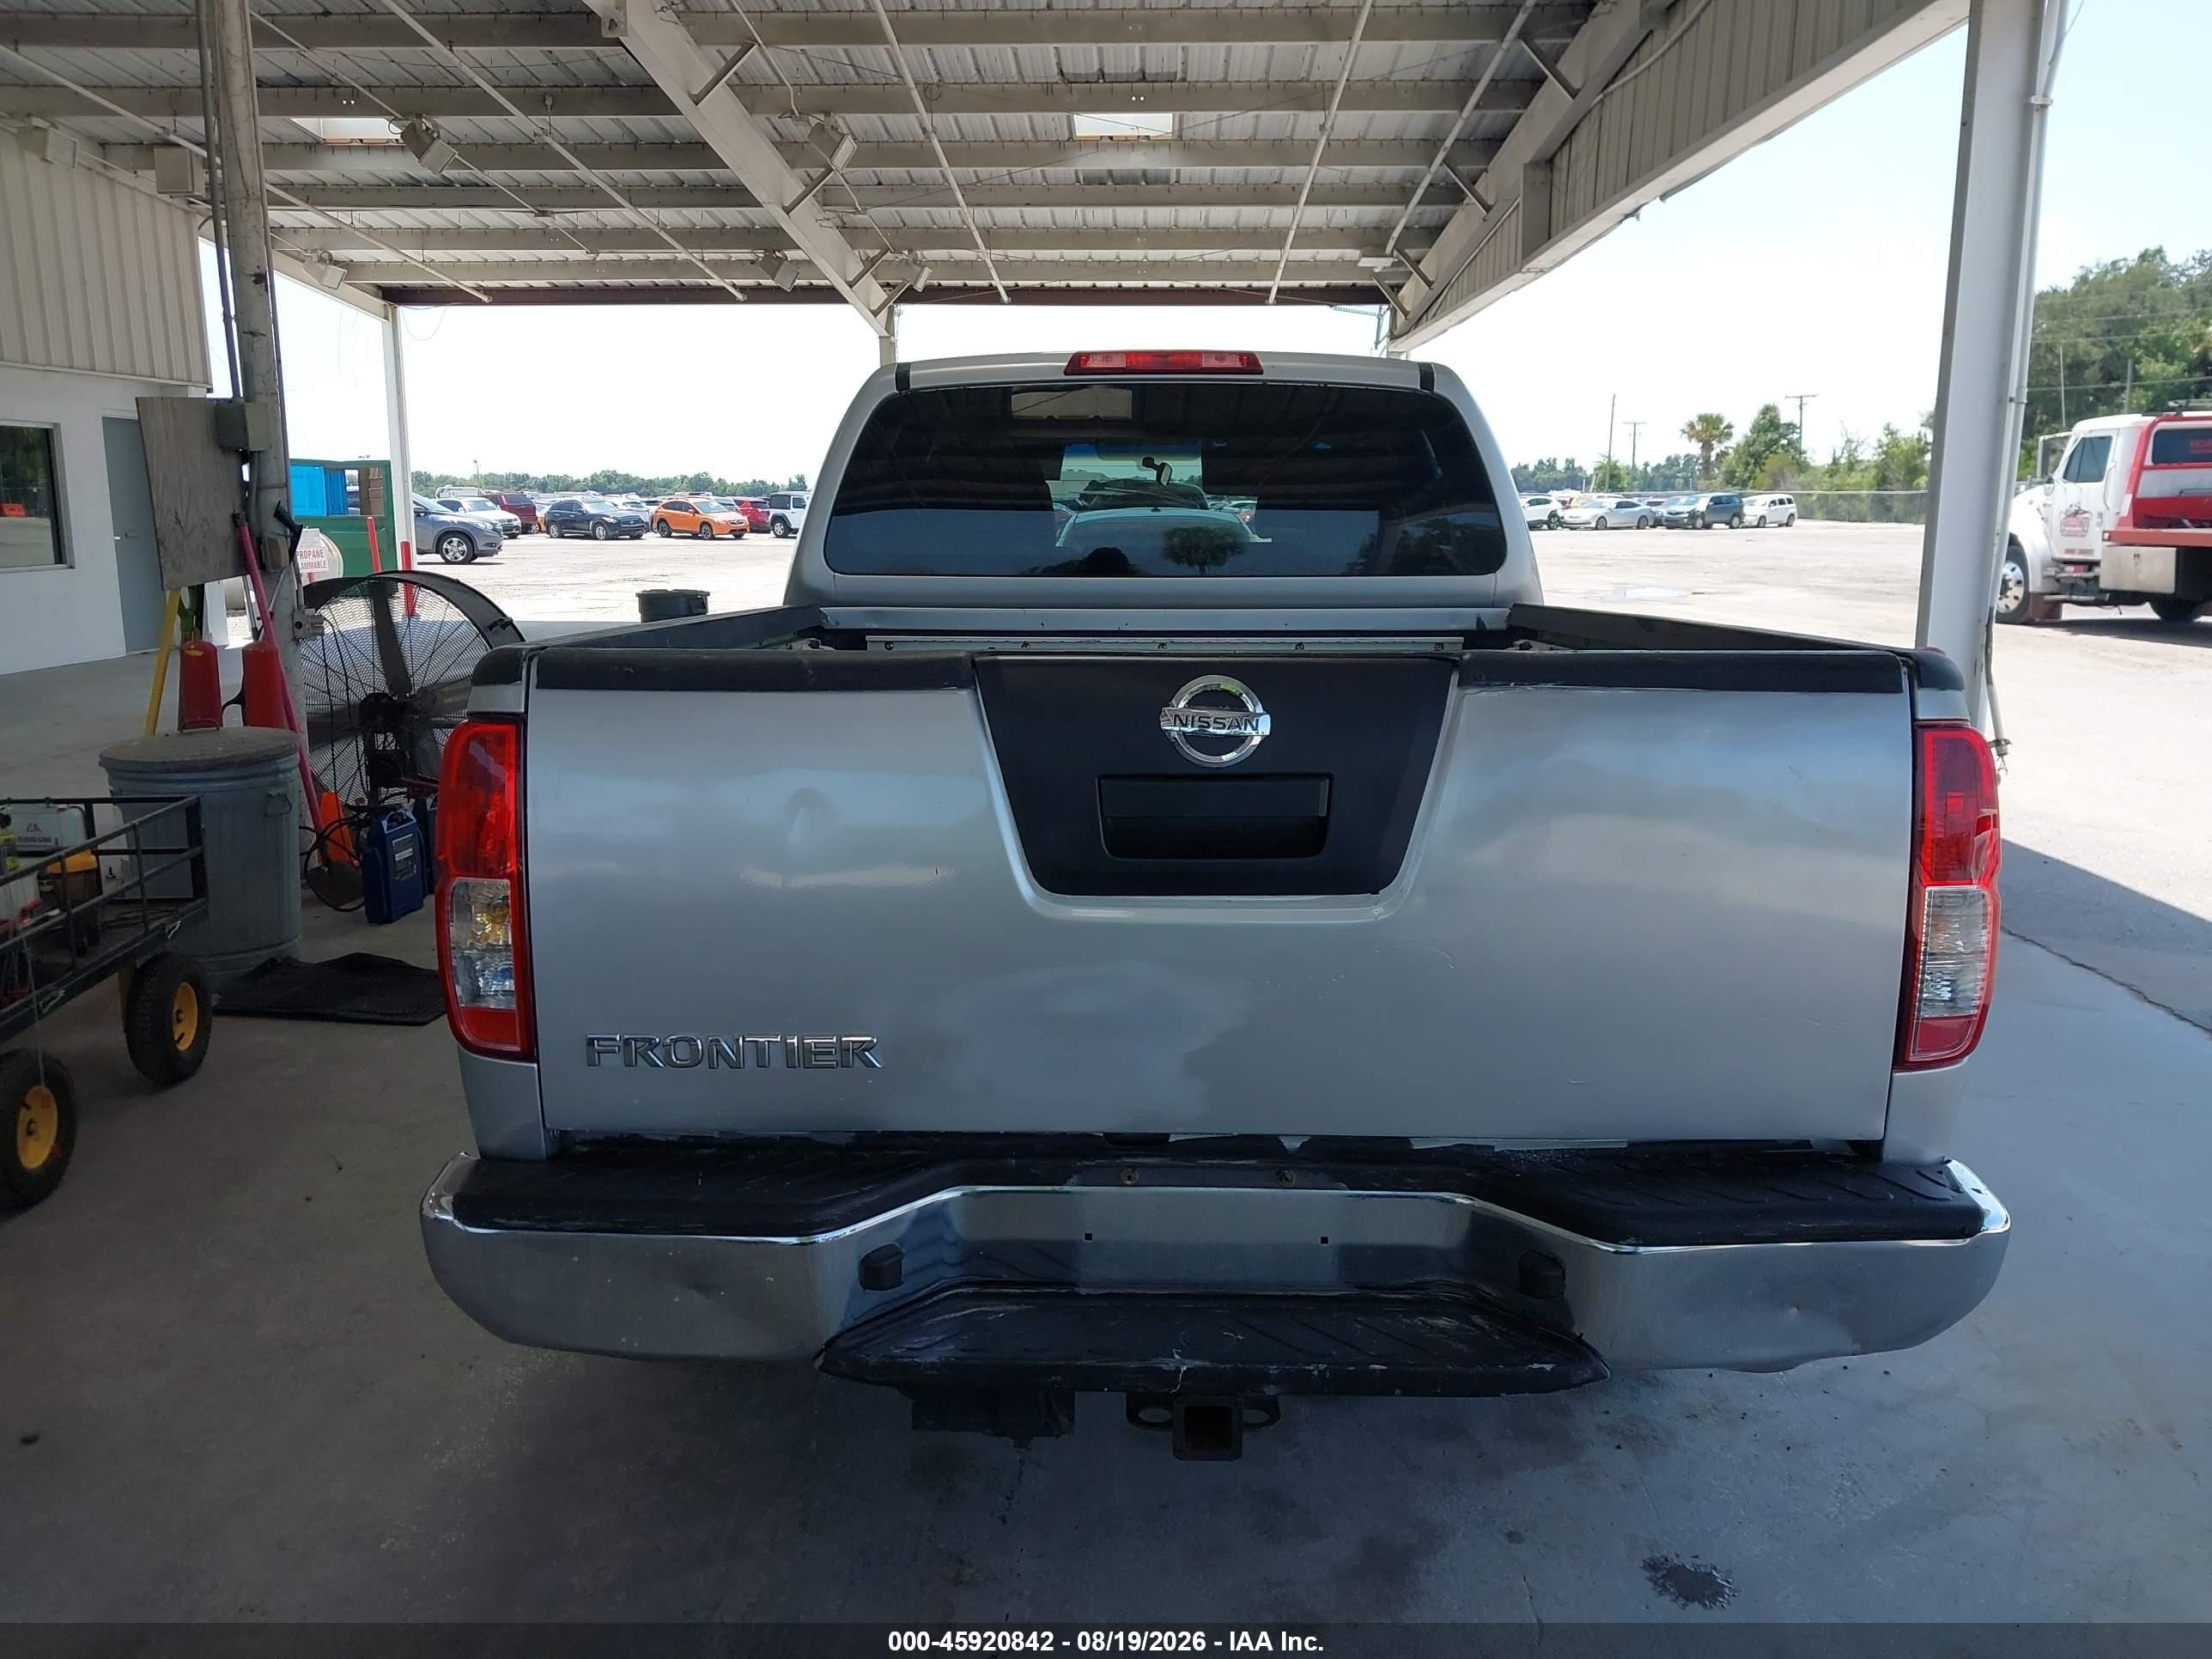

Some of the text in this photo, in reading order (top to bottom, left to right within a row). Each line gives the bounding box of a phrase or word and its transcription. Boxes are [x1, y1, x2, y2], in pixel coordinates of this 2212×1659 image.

[301, 561, 327, 569] AMMABLE
[1173, 714, 1260, 732] NISSAN
[586, 1033, 883, 1069] FRONTIER
